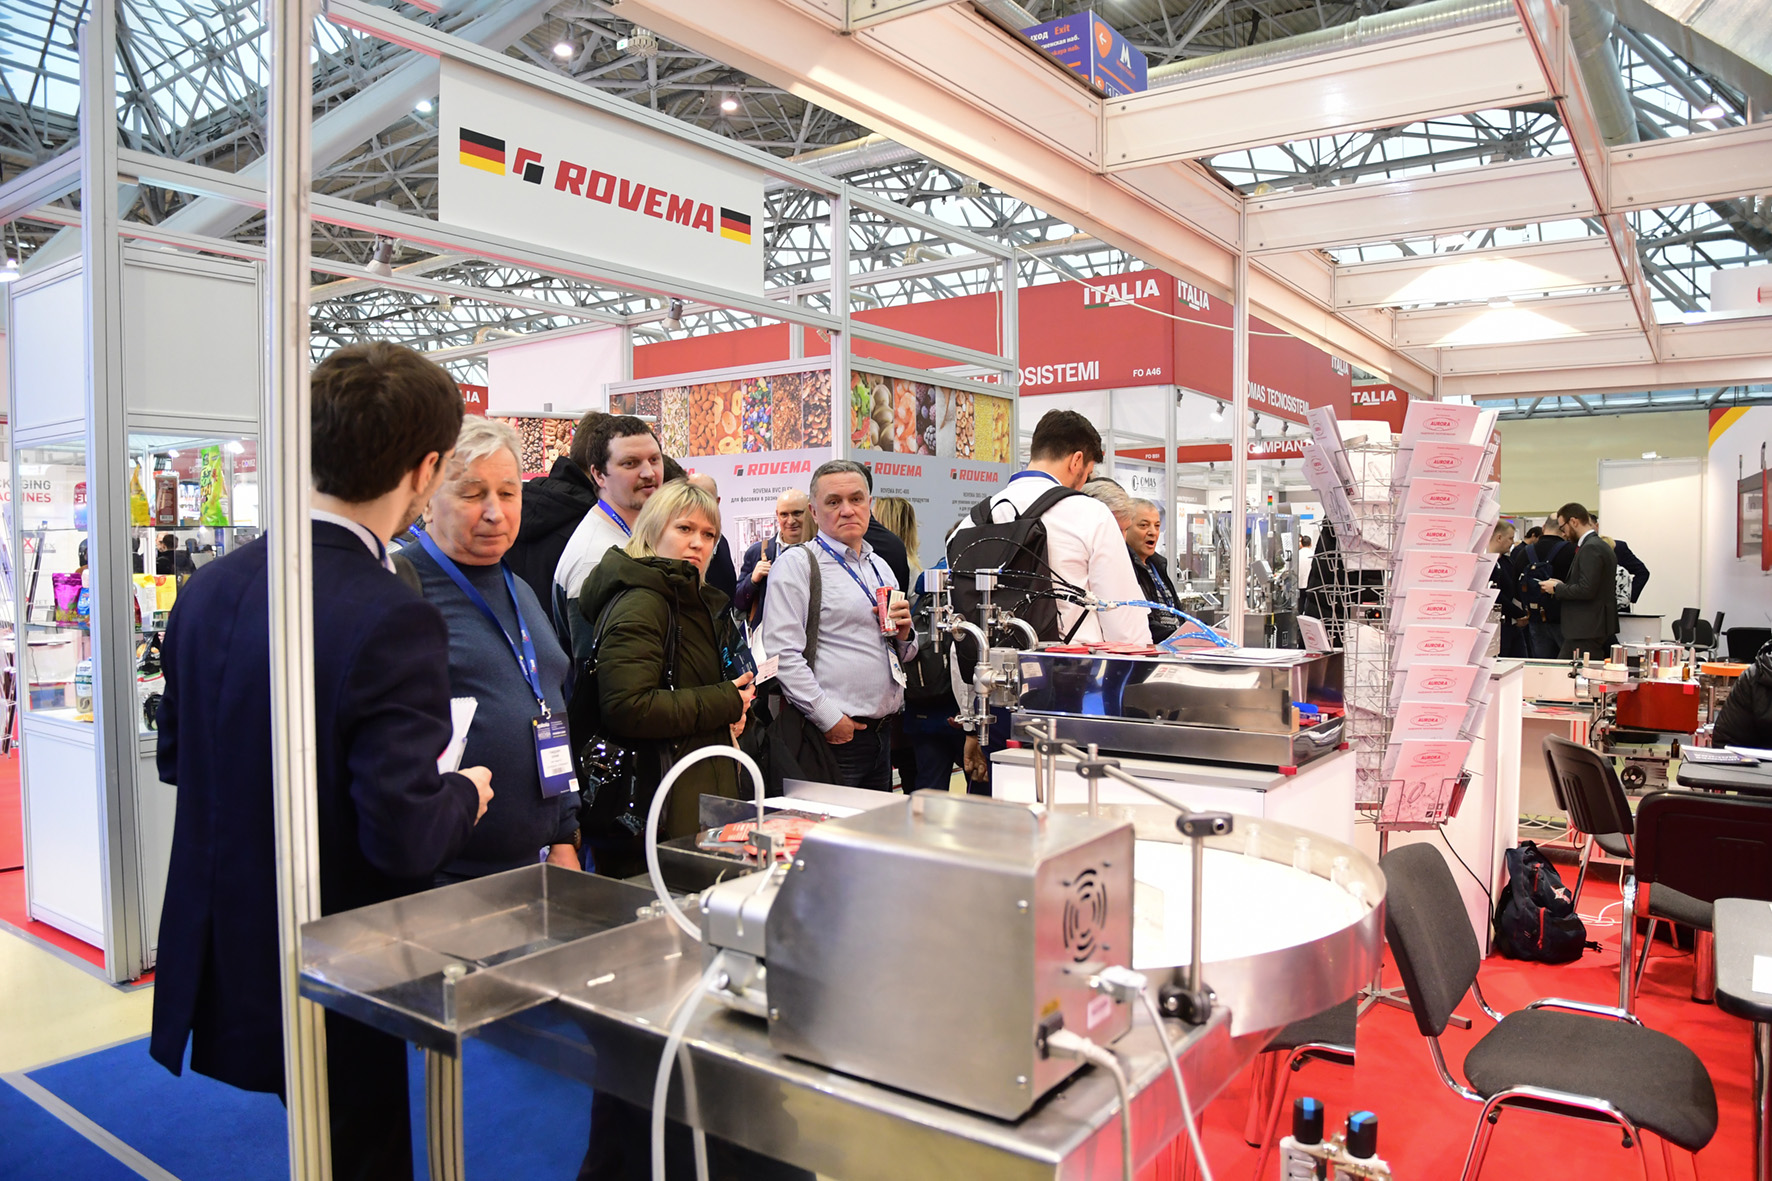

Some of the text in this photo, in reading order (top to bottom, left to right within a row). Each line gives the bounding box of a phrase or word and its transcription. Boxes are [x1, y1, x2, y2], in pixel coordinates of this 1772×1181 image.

[1030, 31, 1049, 42] ход
[1054, 24, 1070, 35] Exit
[554, 160, 714, 233] ROVEMA
[1083, 279, 1160, 305] ITALIA
[1177, 279, 1210, 310] ITALIA
[1132, 366, 1162, 378] FO A46
[1351, 390, 1397, 404] TALIA
[746, 460, 811, 476] ROVEMA
[873, 462, 922, 478] ROVEMA
[958, 468, 999, 483] ROVEMA
